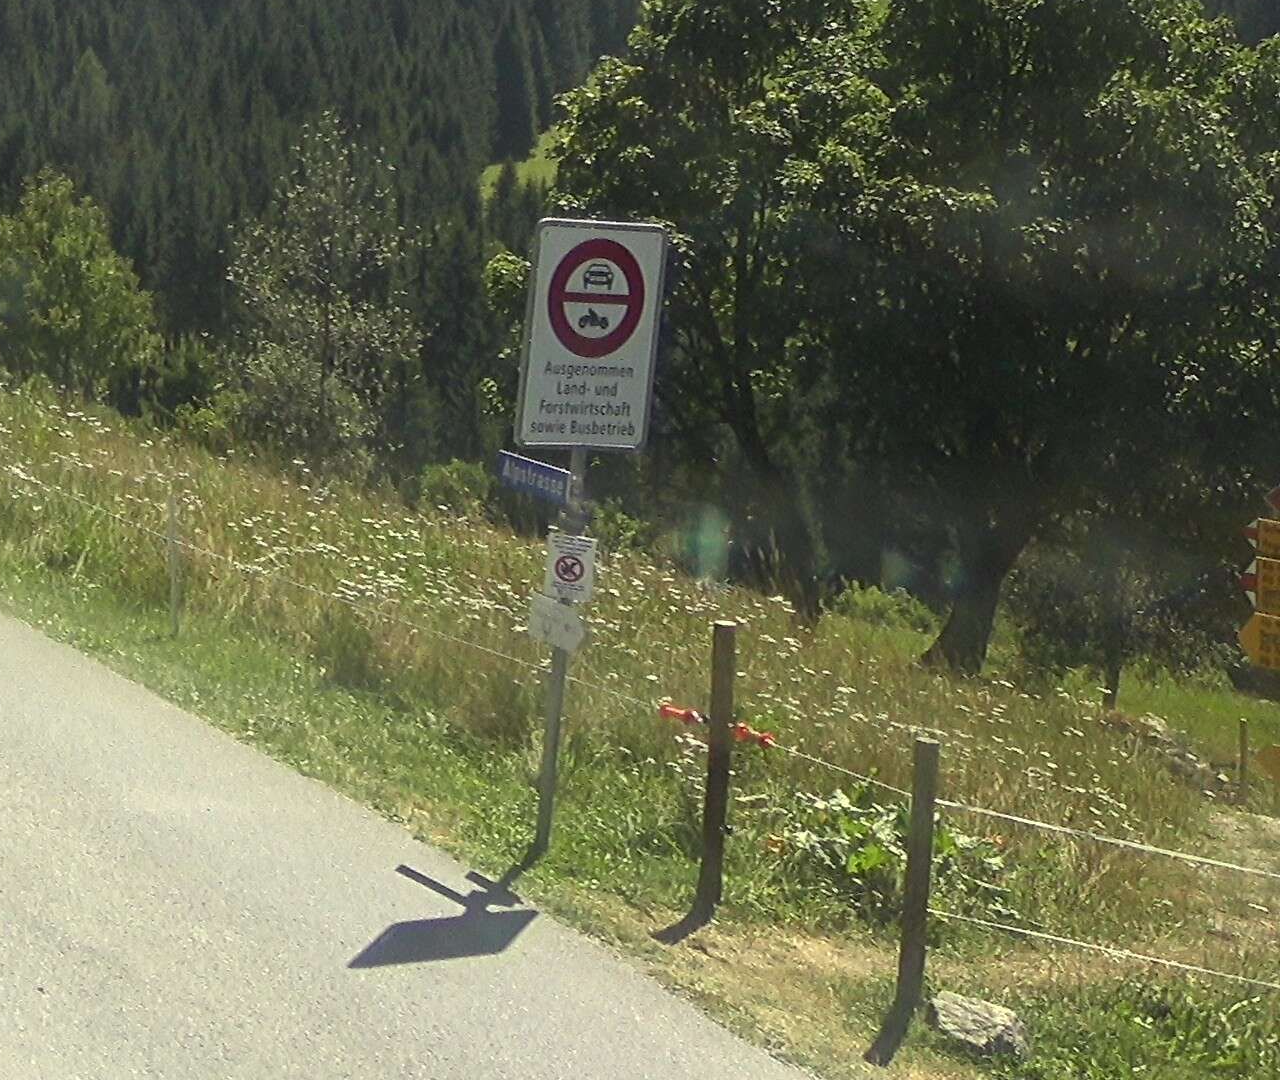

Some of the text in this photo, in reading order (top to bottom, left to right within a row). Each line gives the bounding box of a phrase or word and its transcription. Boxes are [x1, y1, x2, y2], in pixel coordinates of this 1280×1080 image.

[544, 360, 634, 379] Ausgenommen
[556, 381, 617, 397] Land- und
[539, 399, 631, 416] Forstwirtschaft
[530, 420, 635, 436] sowie Busbetrieb
